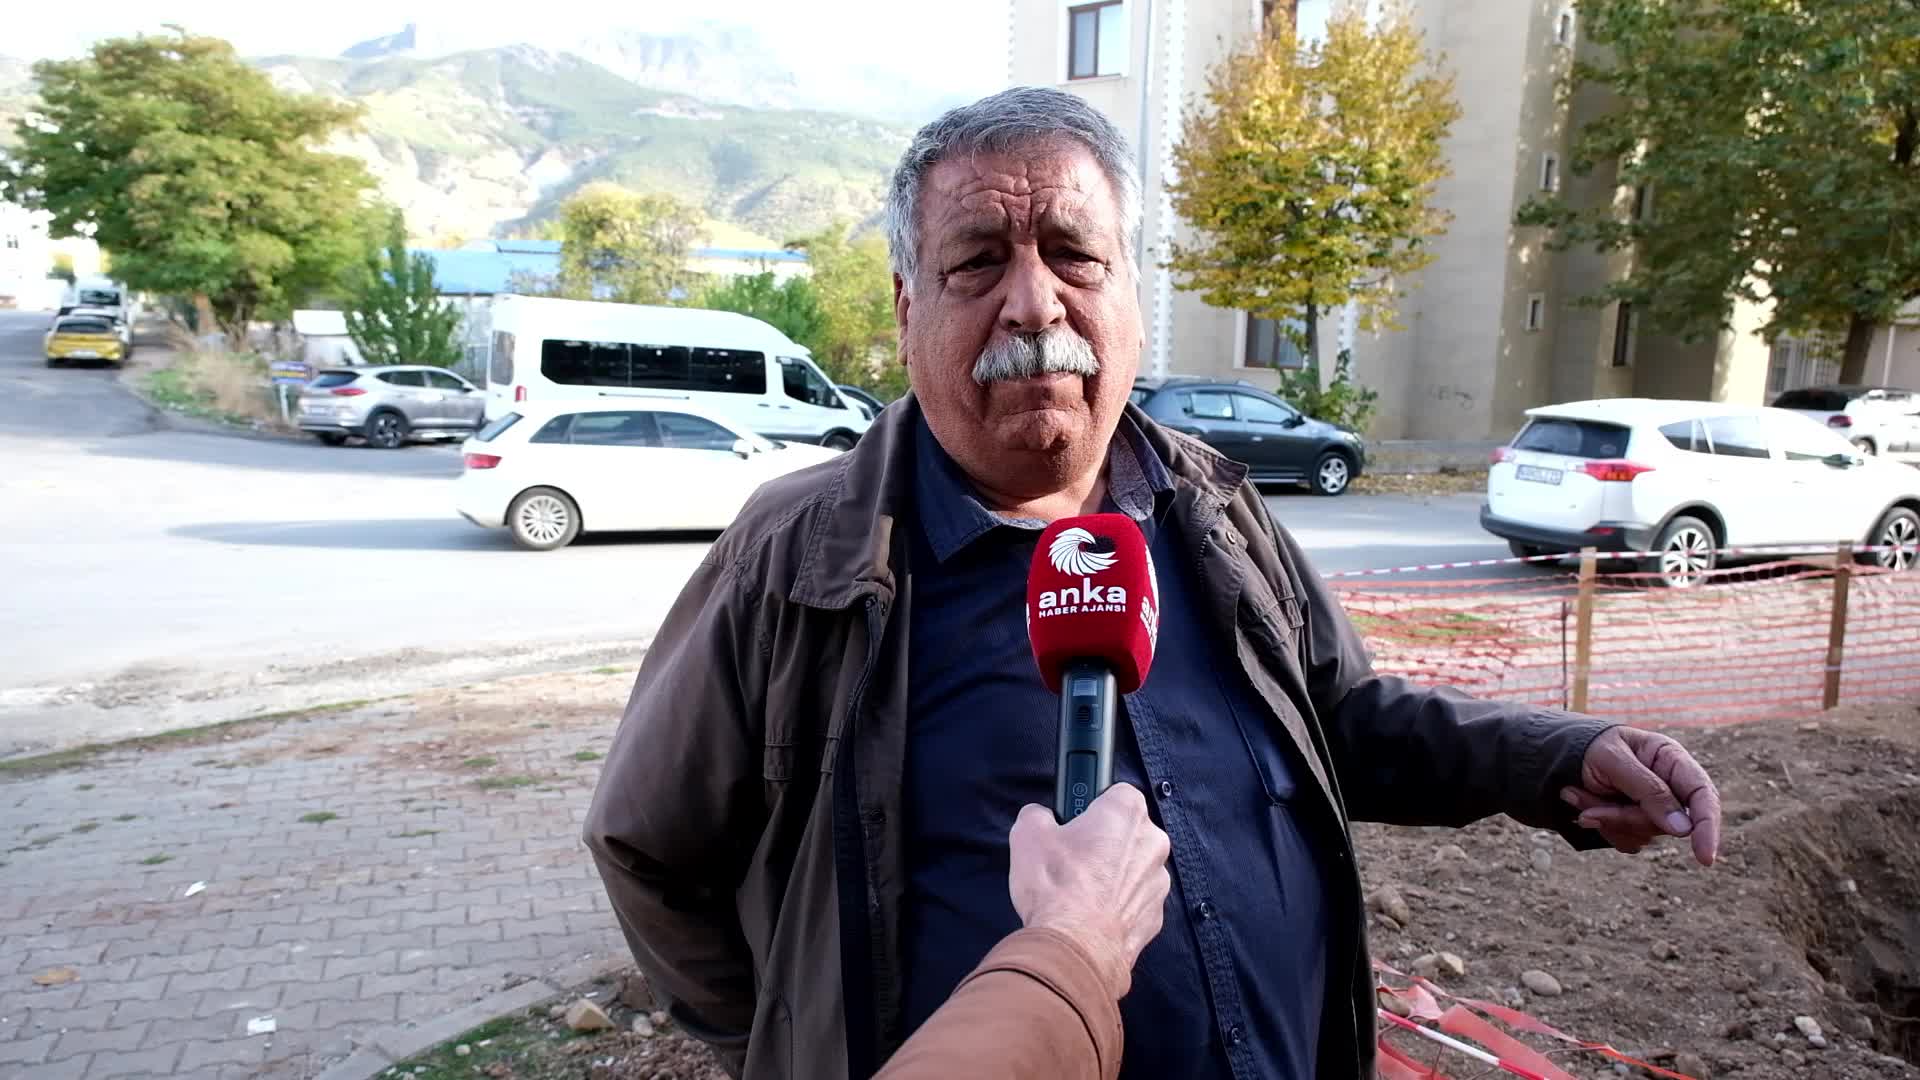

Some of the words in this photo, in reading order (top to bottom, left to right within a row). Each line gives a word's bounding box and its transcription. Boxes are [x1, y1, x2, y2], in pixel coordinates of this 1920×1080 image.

[1039, 577, 1126, 608] anka
[1039, 605, 1078, 618] HABER
[1081, 604, 1126, 613] AJANSI
